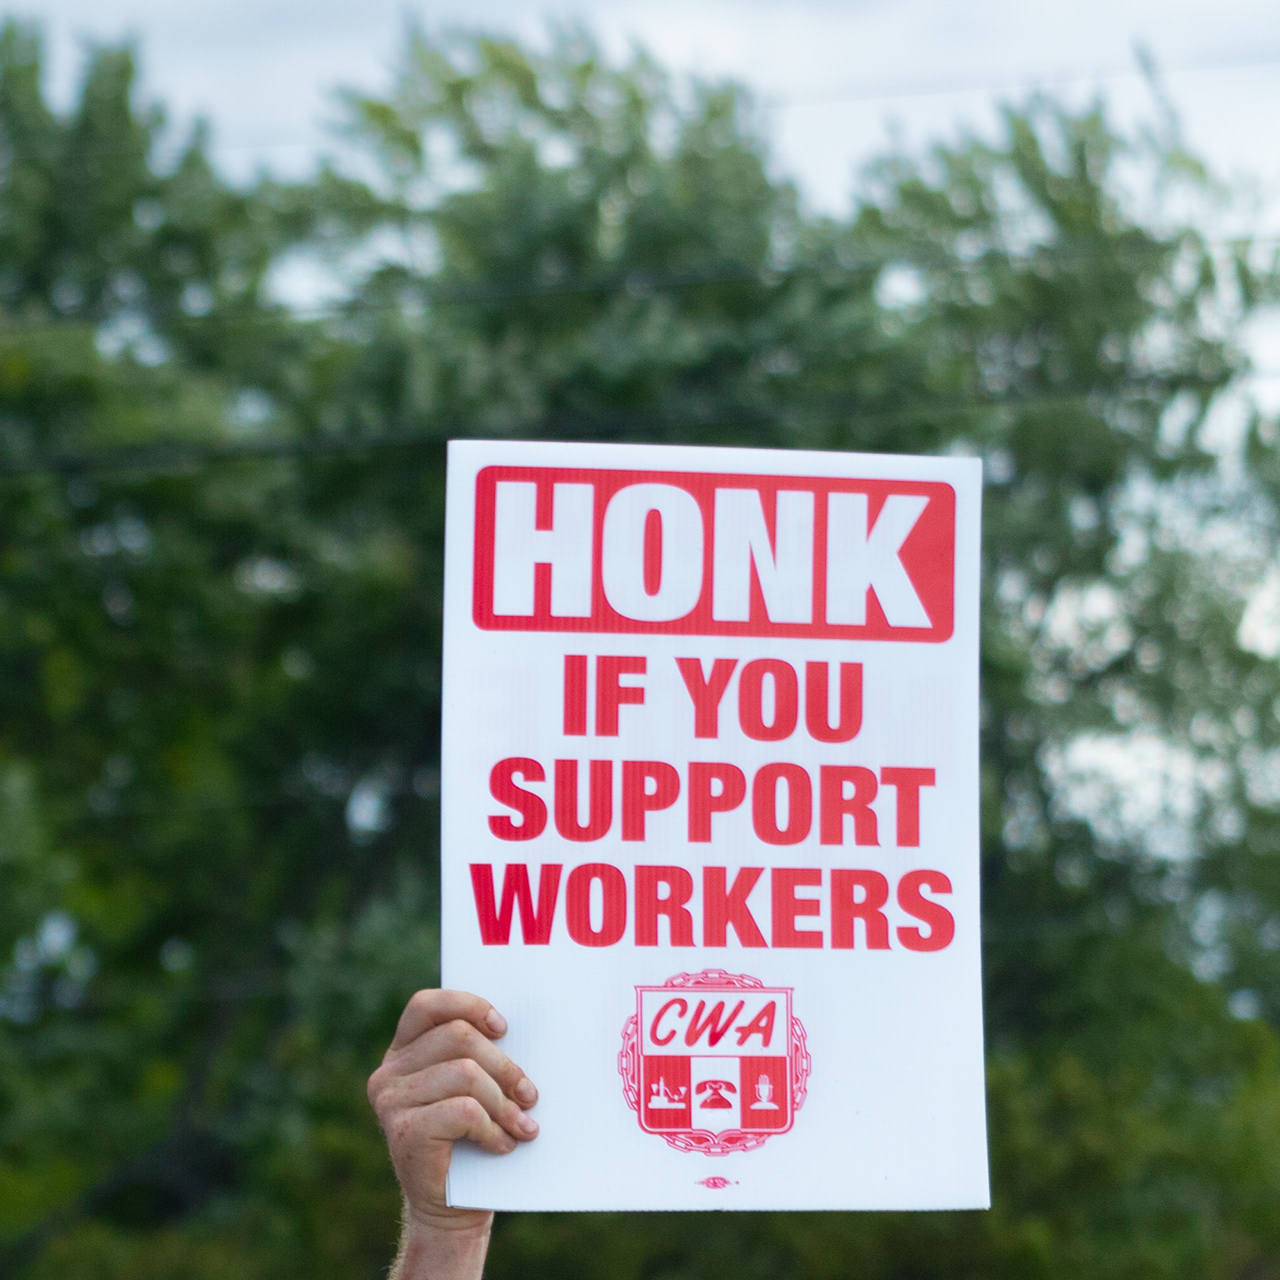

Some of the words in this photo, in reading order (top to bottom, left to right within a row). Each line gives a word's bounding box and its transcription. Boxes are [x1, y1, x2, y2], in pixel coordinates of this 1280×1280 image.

[493, 482, 932, 628] HONK
[563, 655, 647, 736] IF
[675, 658, 863, 743] YOU
[488, 757, 935, 847] SUPPORT
[469, 863, 955, 952] WORKERS
[650, 998, 776, 1047] CWA
